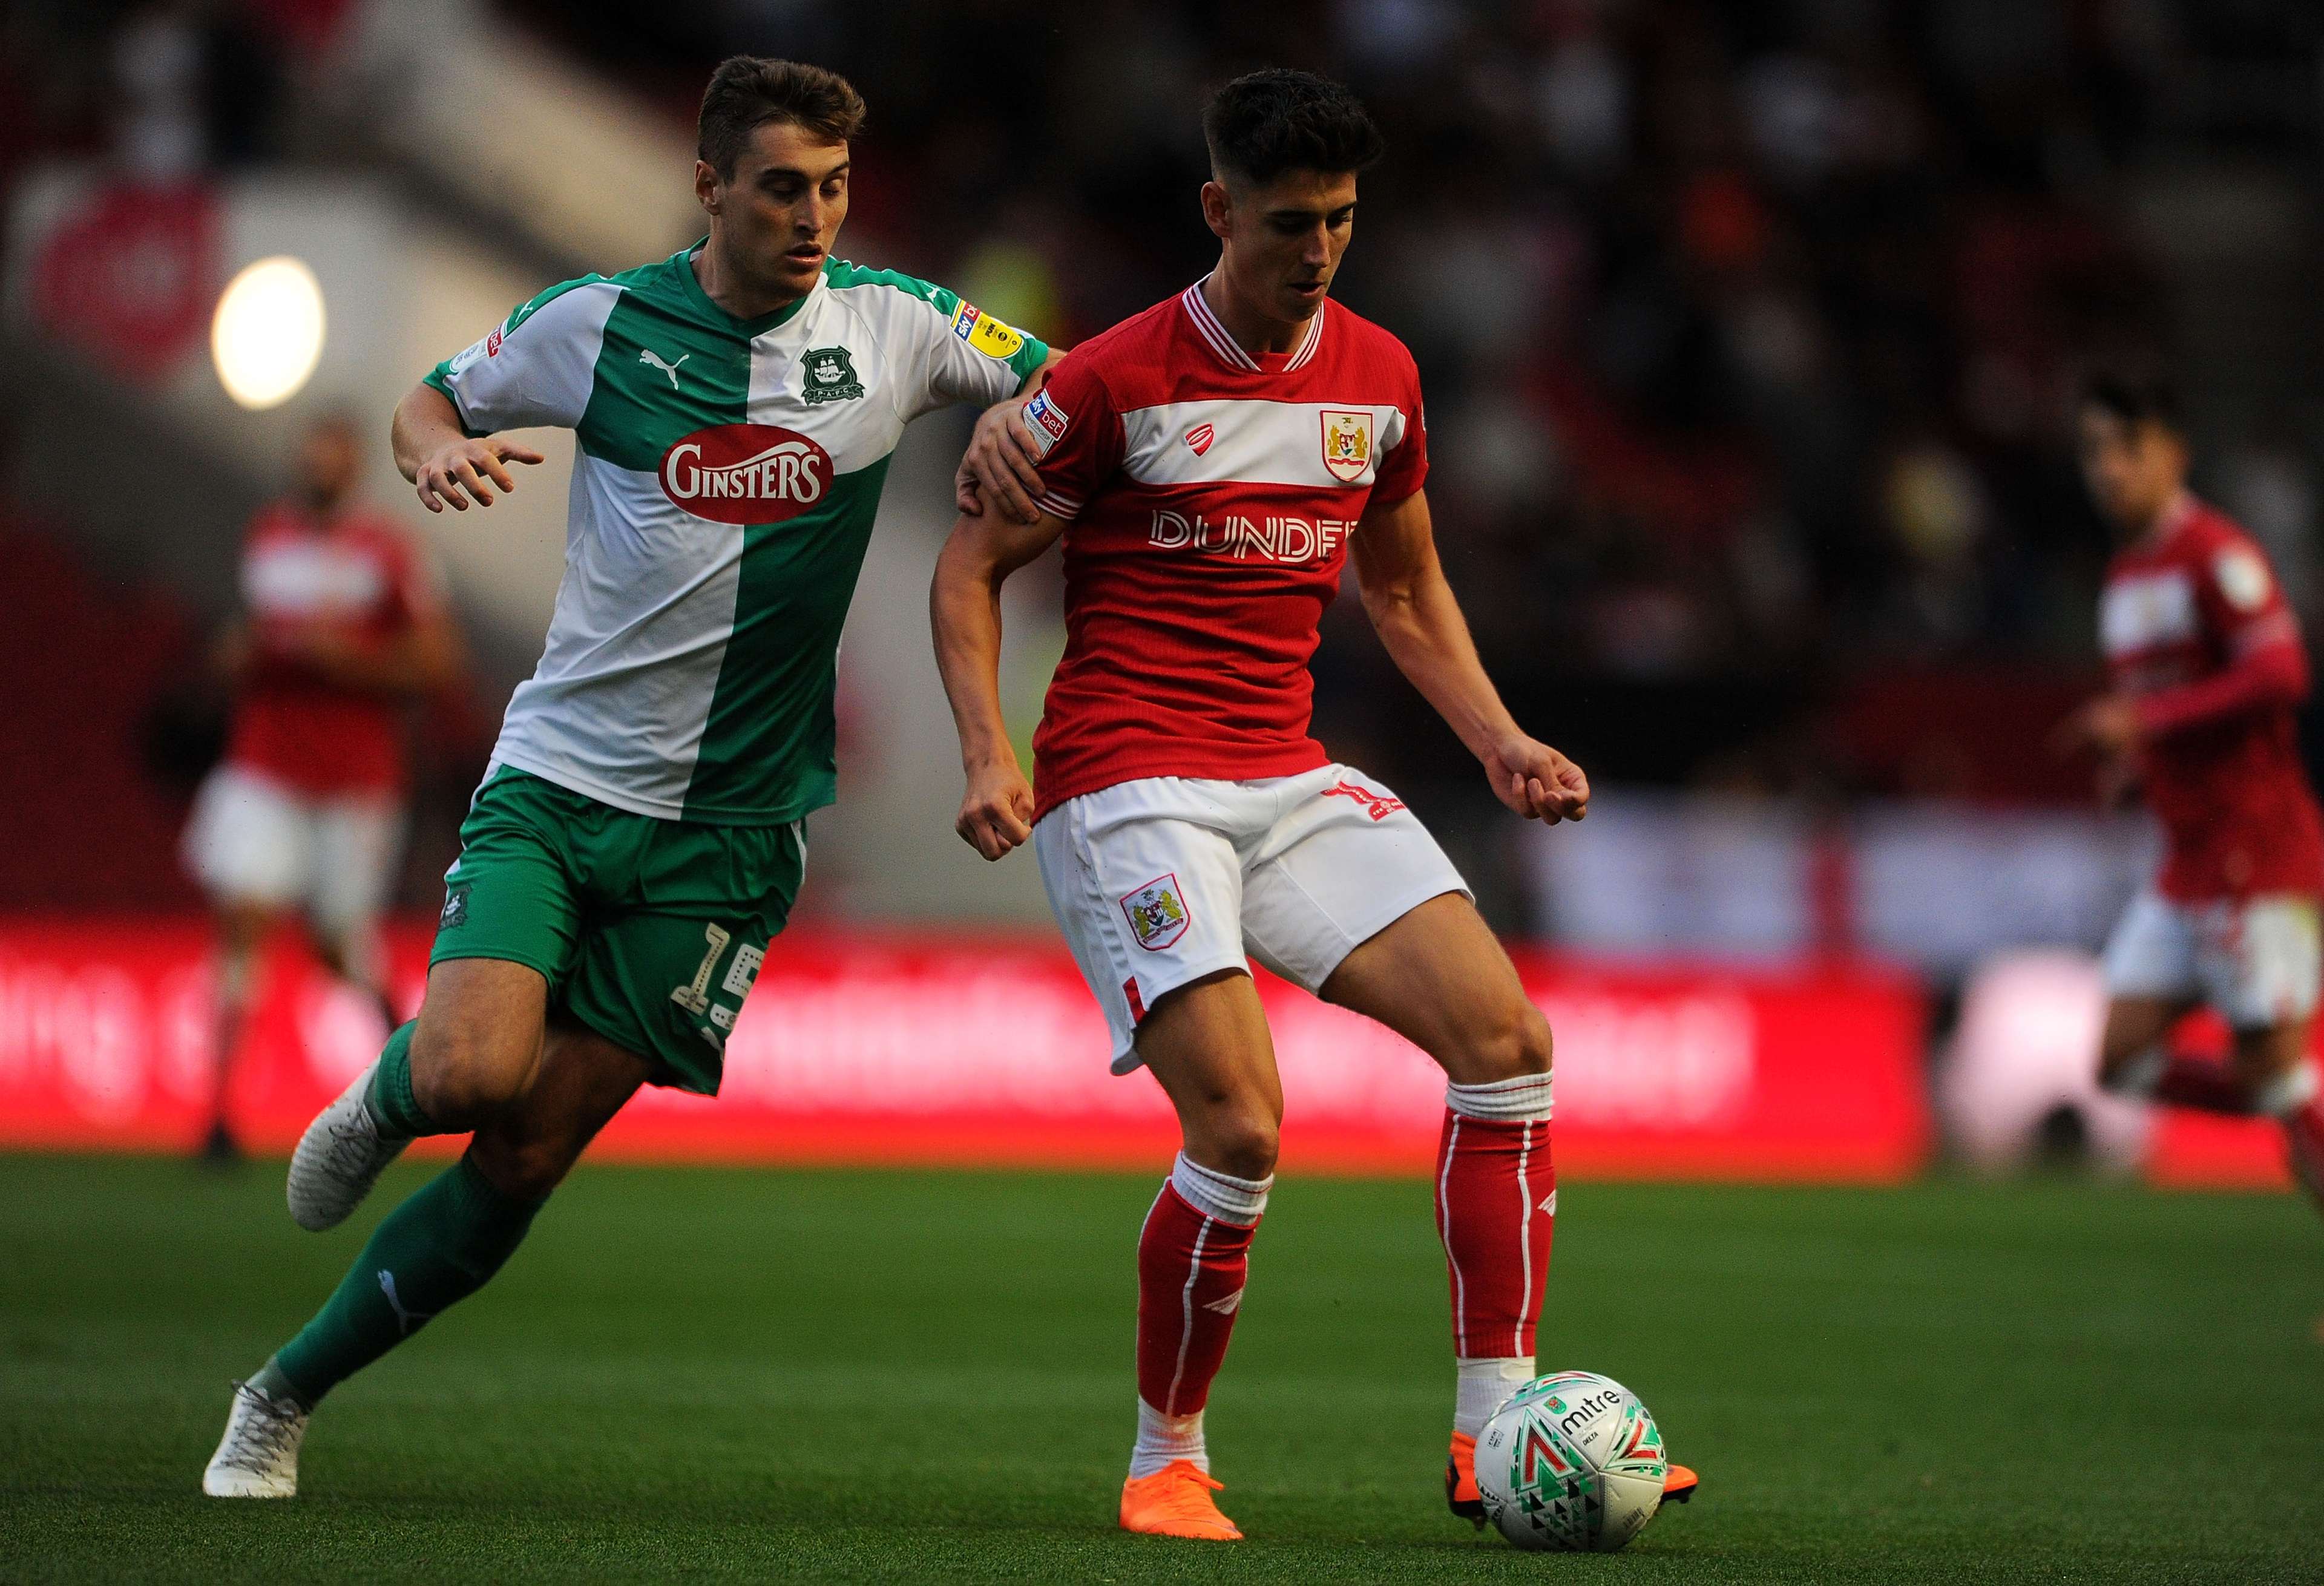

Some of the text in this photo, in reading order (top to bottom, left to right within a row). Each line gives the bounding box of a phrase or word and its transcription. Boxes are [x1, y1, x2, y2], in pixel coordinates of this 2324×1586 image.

[958, 316, 972, 337] sky
[1042, 410, 1061, 434] bet
[666, 441, 821, 503] GINSTERS
[1561, 1391, 1620, 1436] mitre
[1583, 1432, 1598, 1446] DELTA
